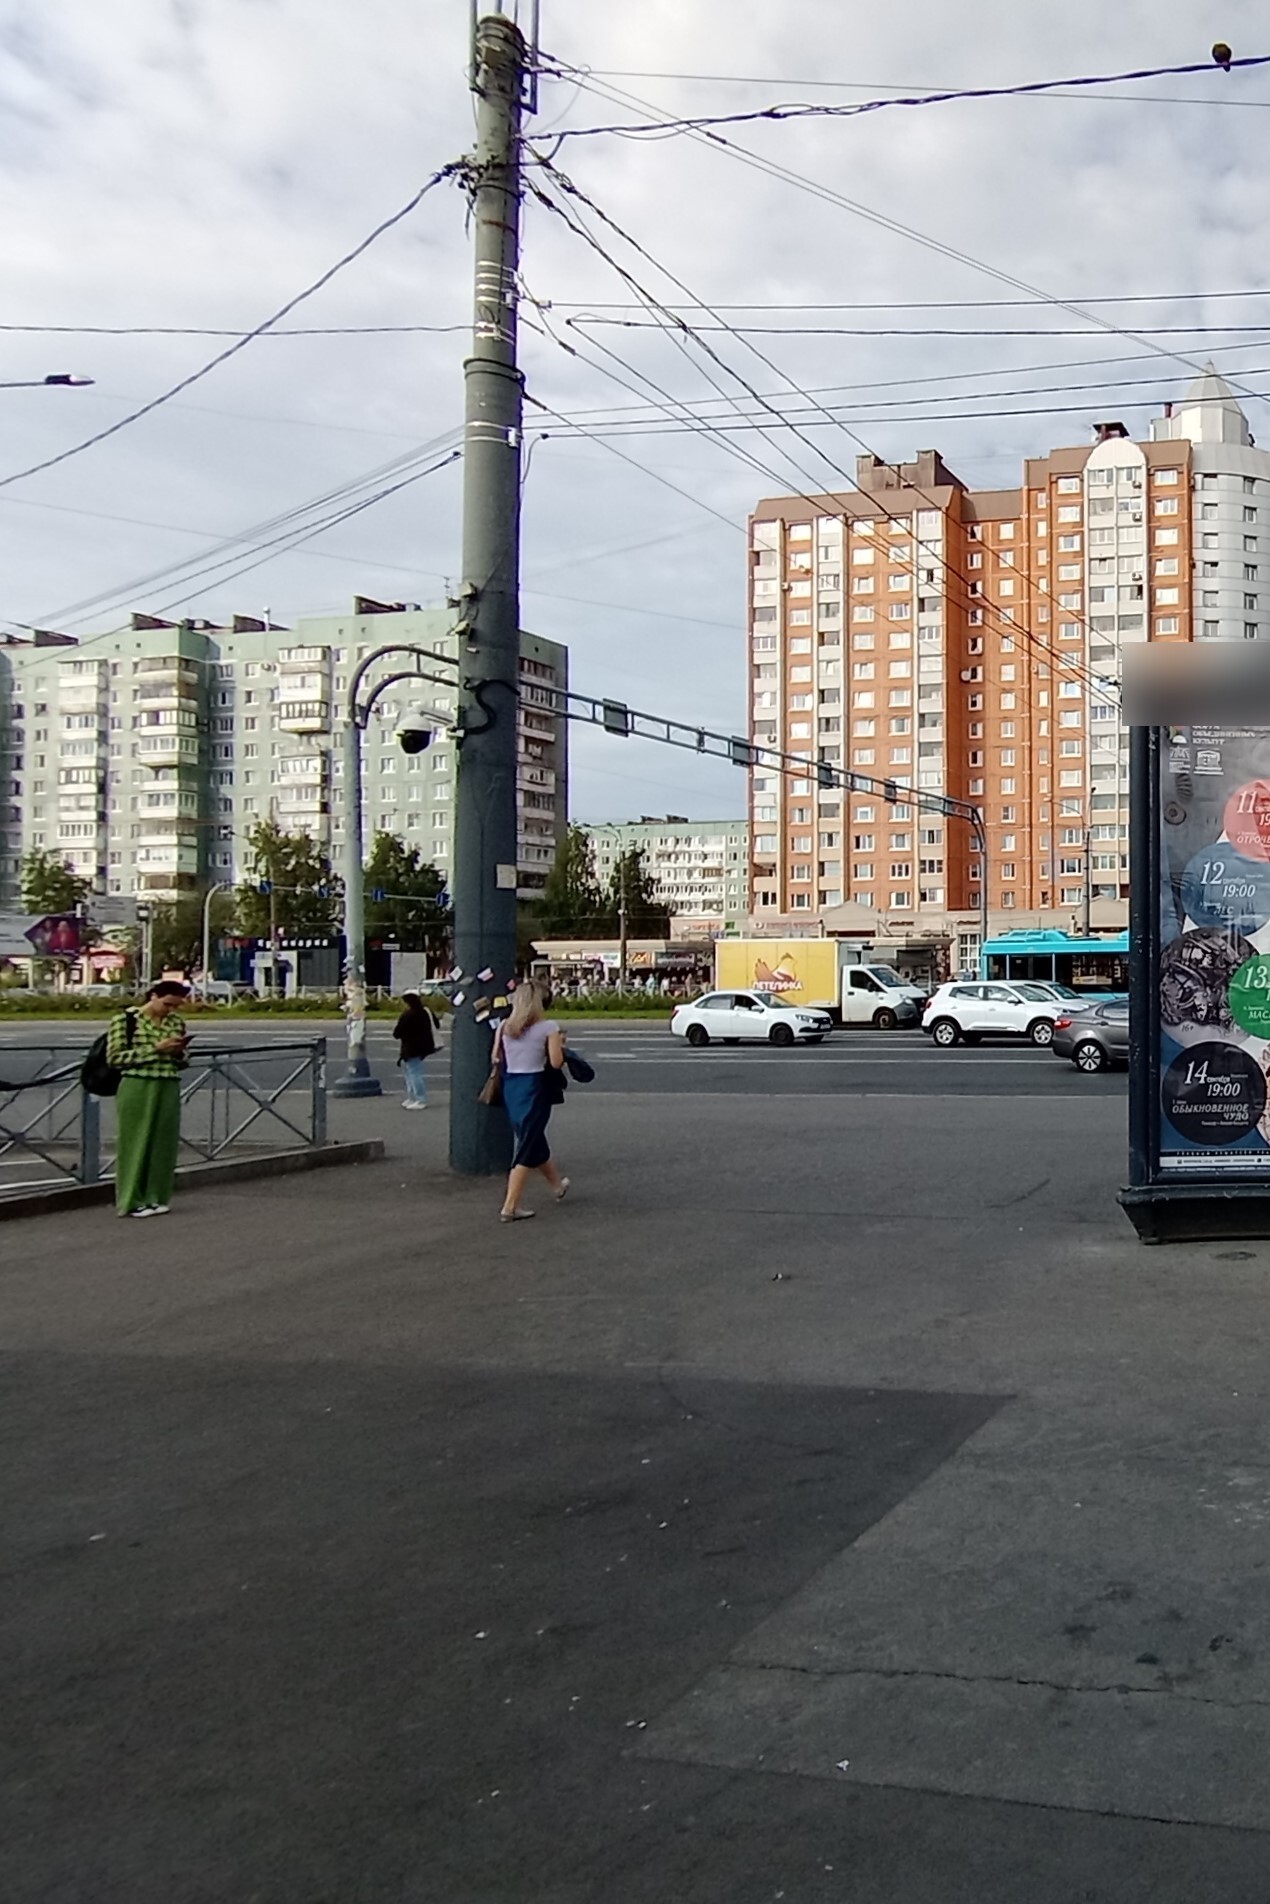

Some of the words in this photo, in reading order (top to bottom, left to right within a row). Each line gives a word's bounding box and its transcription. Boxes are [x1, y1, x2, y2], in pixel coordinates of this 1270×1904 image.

[1236, 790, 1257, 814] 11
[1200, 861, 1225, 885] 12
[1222, 884, 1256, 898] 19:00
[1243, 965, 1268, 989] 13
[1184, 1060, 1209, 1084] 14
[1207, 1083, 1241, 1097] 19:00
[1172, 1104, 1249, 1113] ОБЫКНОВЕННОЕ
[1223, 1112, 1249, 1121] ЧУДО
